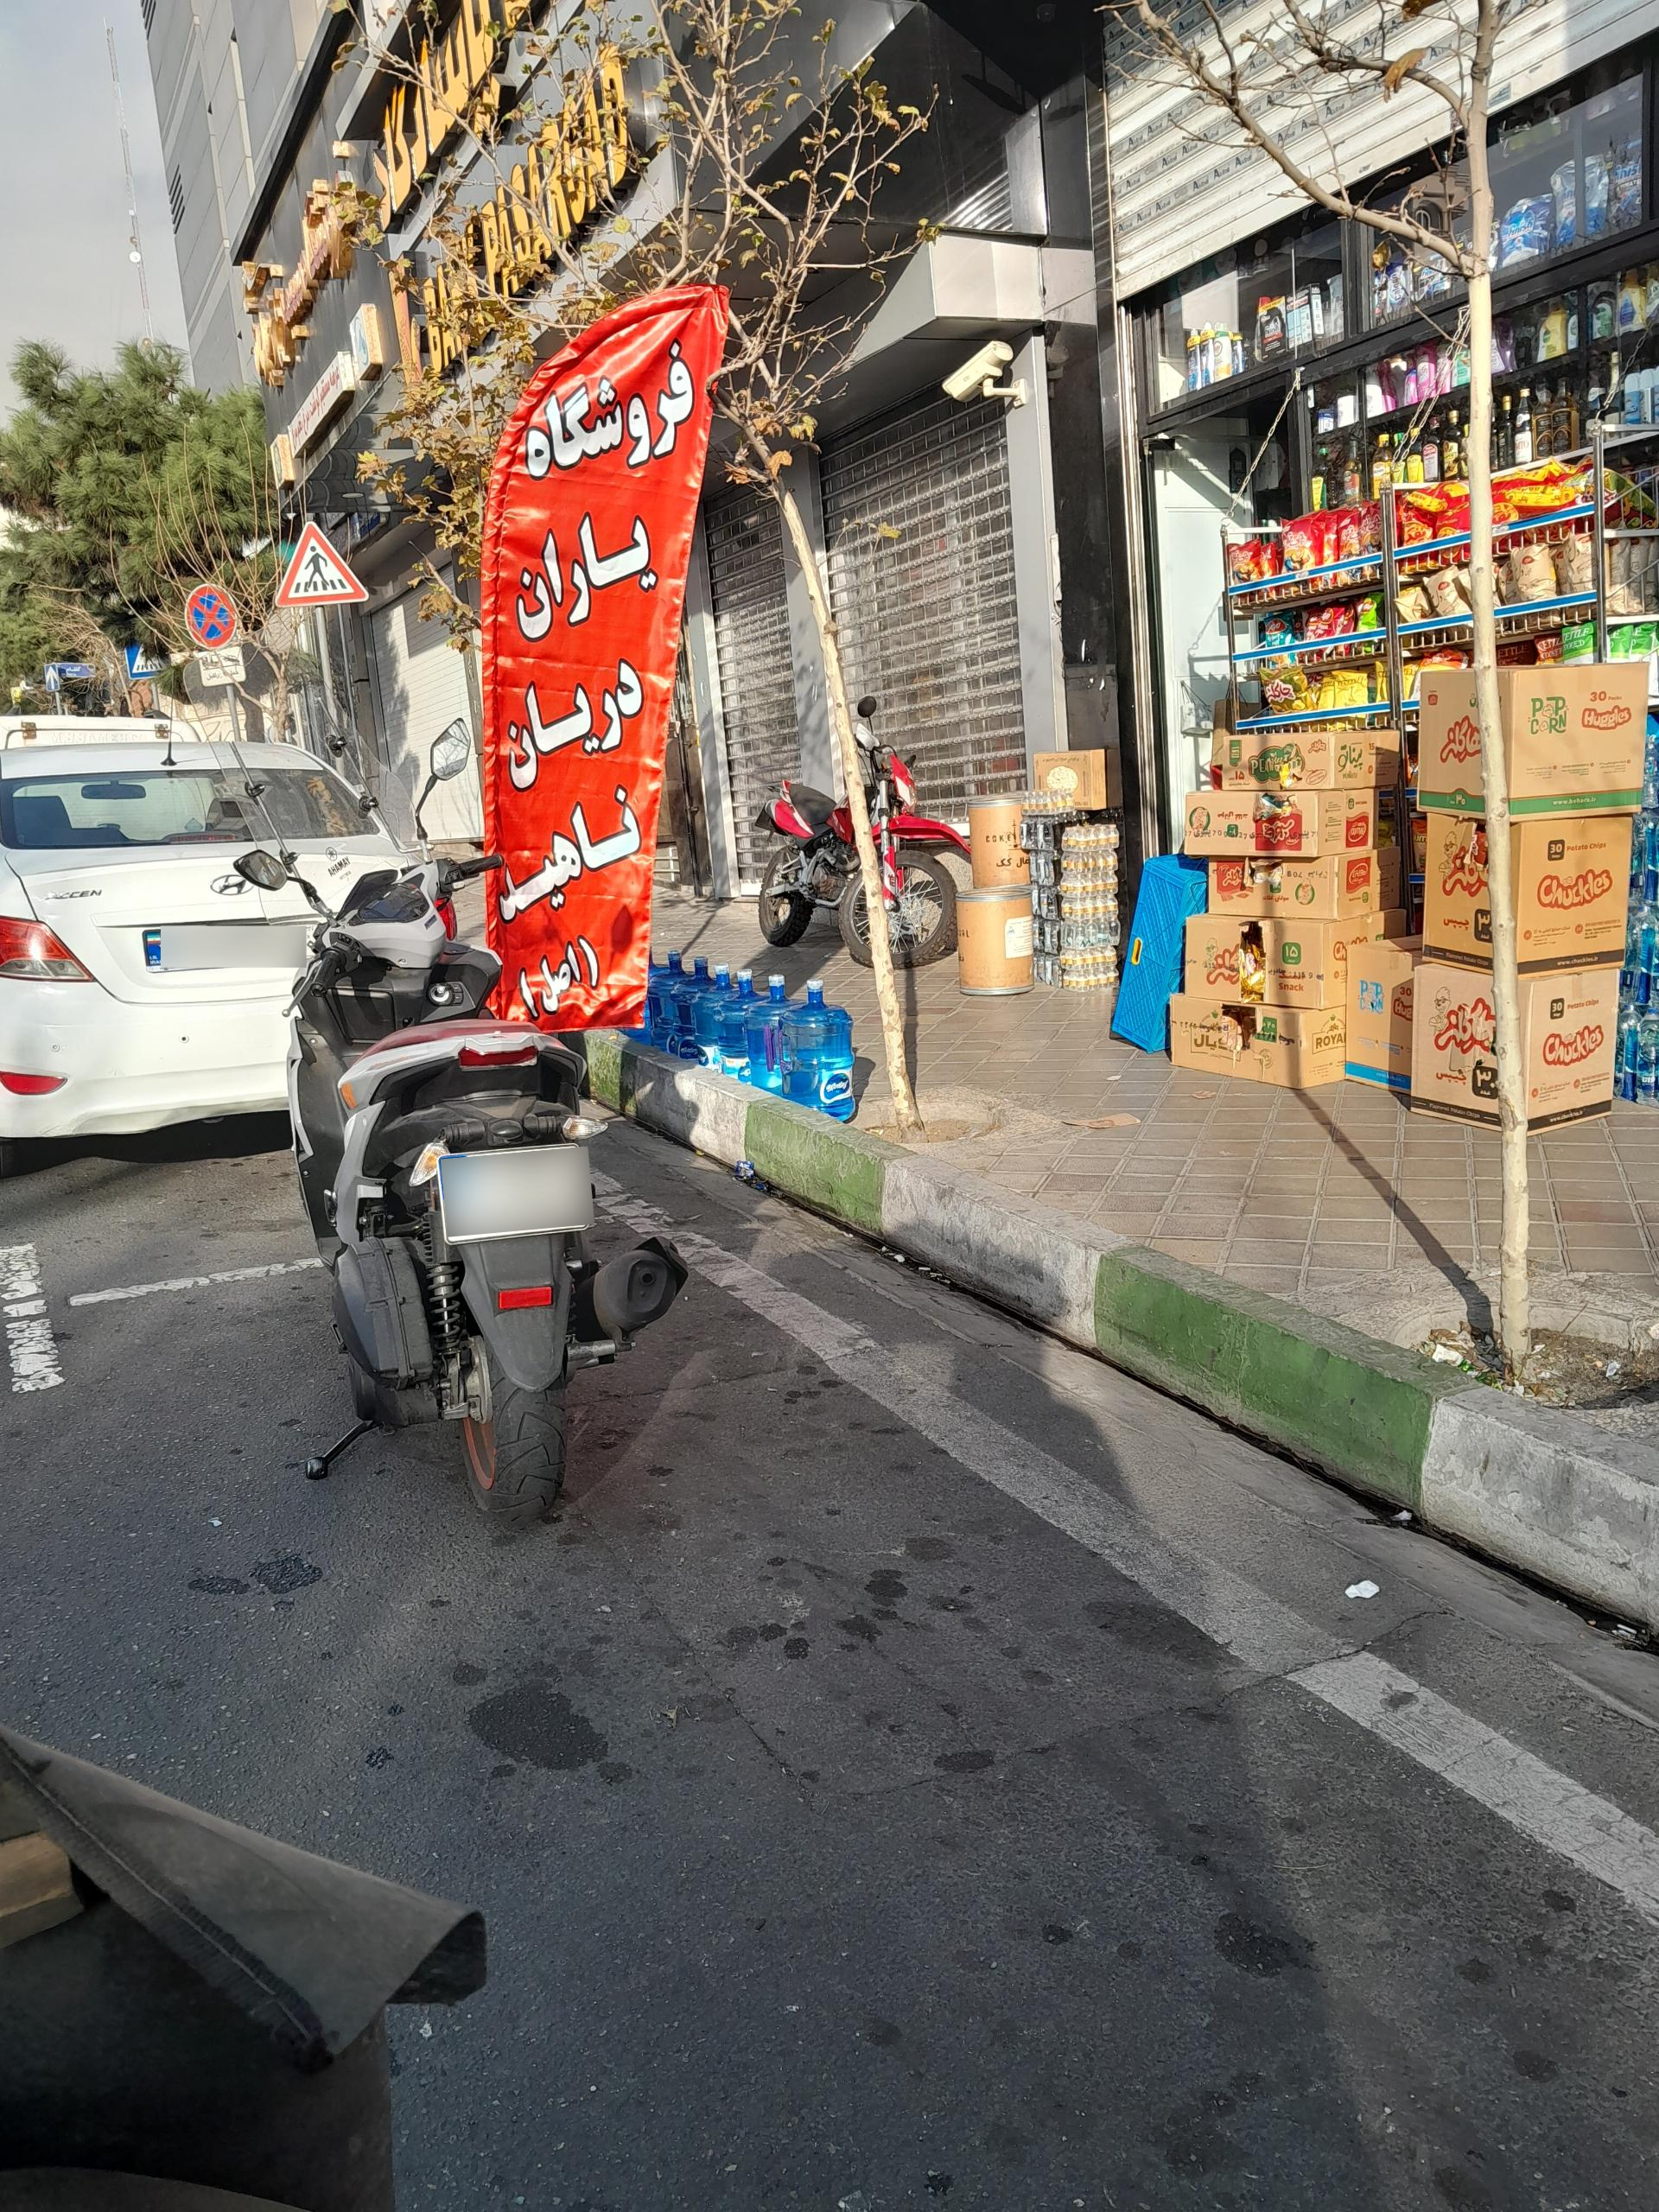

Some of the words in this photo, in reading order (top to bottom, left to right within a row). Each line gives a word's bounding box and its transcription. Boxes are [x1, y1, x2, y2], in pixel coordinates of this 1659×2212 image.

[524, 337, 696, 481] فروشگاه
[517, 512, 658, 642] یاران
[1590, 691, 1607, 702] 30
[508, 658, 643, 791] دریان
[1583, 705, 1631, 730] Huggles
[499, 785, 642, 924] ناهید
[1549, 843, 1563, 854] 30
[1567, 843, 1589, 852] Potato
[1537, 869, 1612, 910] Chuckles
[1443, 917, 1470, 931] چیپس
[1285, 945, 1299, 957] ۱۵
[1279, 982, 1304, 992] Snack
[1400, 986, 1412, 996] 30
[1551, 1001, 1563, 1013] 30
[1567, 1001, 1586, 1010] Potato
[1543, 1026, 1605, 1066] Chuckles
[1436, 1072, 1467, 1086] چیپس
